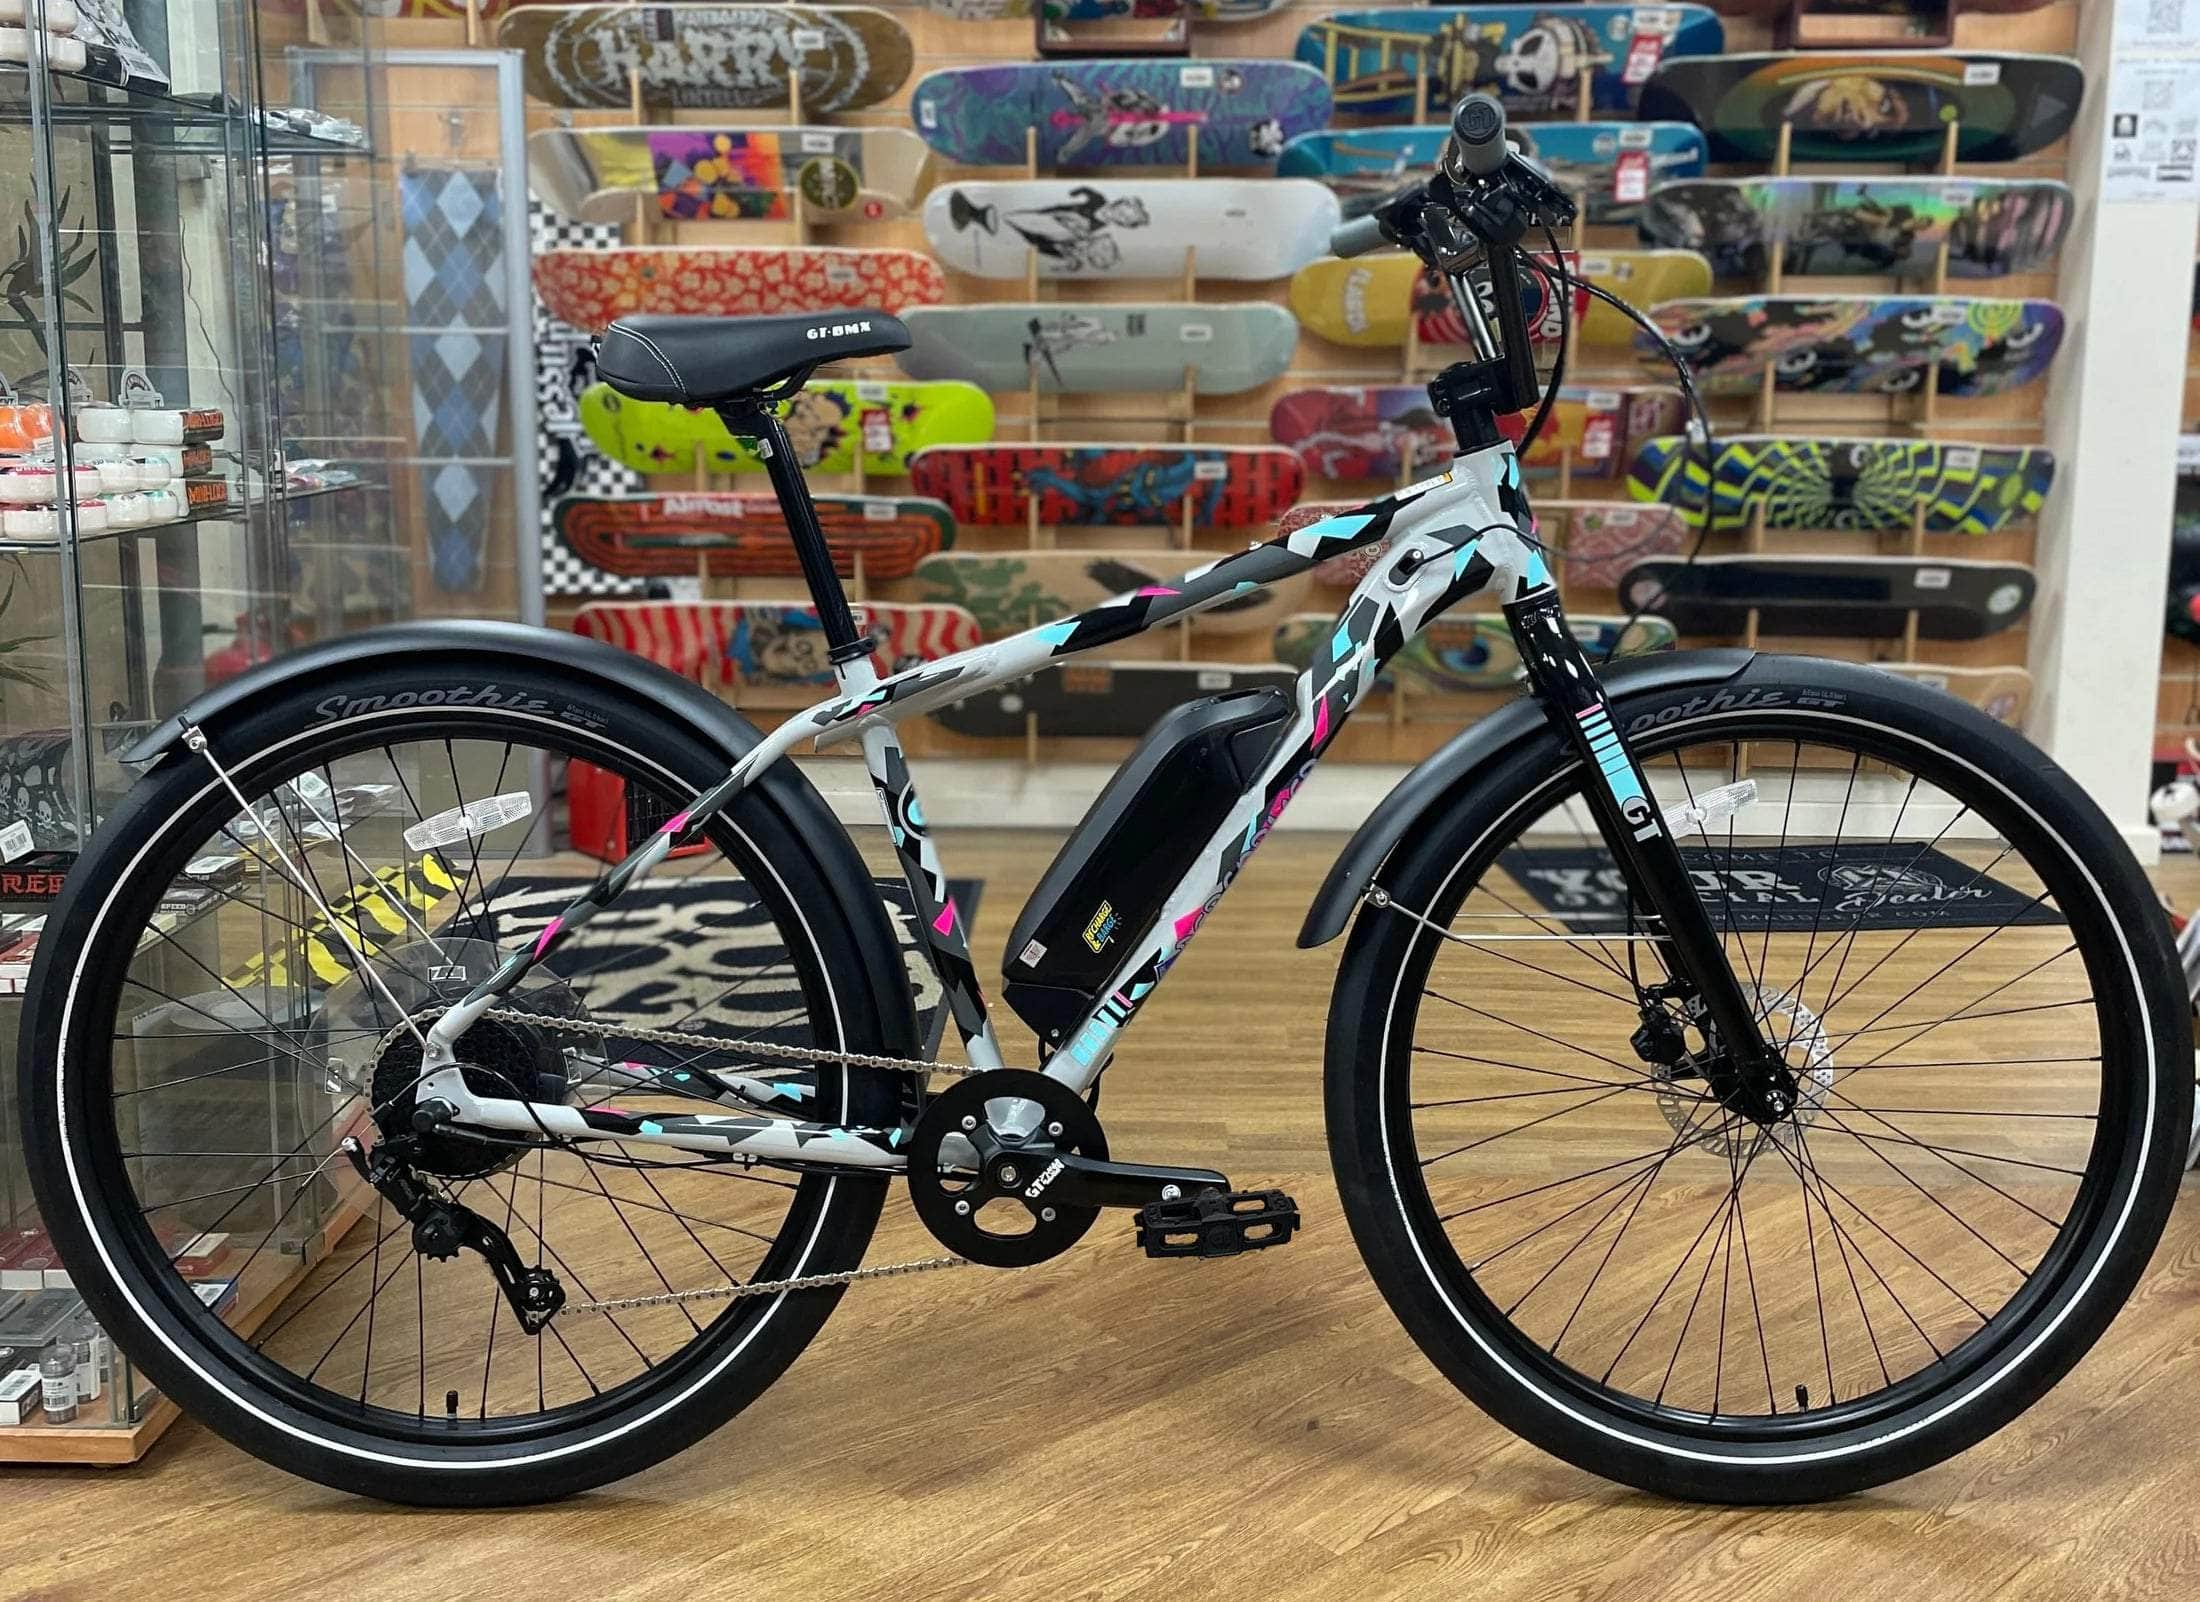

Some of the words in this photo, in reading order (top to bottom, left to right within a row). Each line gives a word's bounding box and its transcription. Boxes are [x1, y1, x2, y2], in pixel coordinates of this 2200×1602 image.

[304, 684, 555, 728] Smoothie
[1628, 688, 1791, 731] oothie
[1622, 797, 1662, 842] GT
